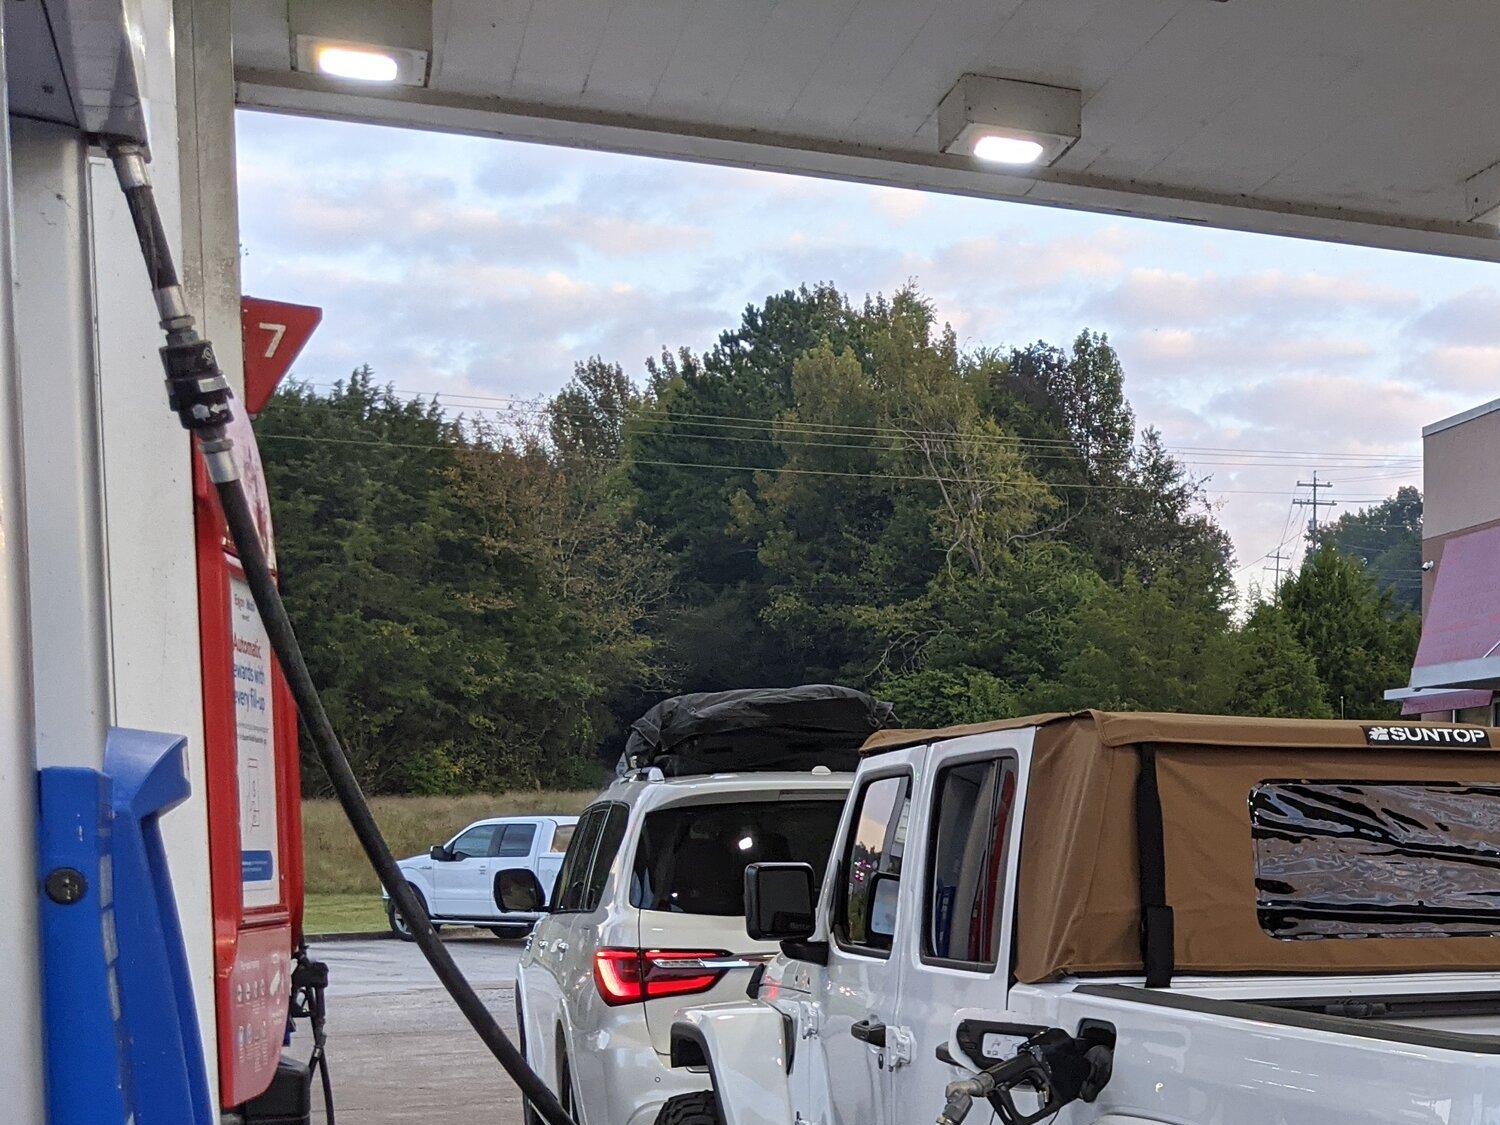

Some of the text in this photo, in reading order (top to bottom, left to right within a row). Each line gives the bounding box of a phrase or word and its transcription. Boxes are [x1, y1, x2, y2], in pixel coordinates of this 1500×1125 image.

[259, 322, 286, 358] 7
[233, 664, 254, 682] ewards
[1389, 727, 1485, 743] SUNTOP
